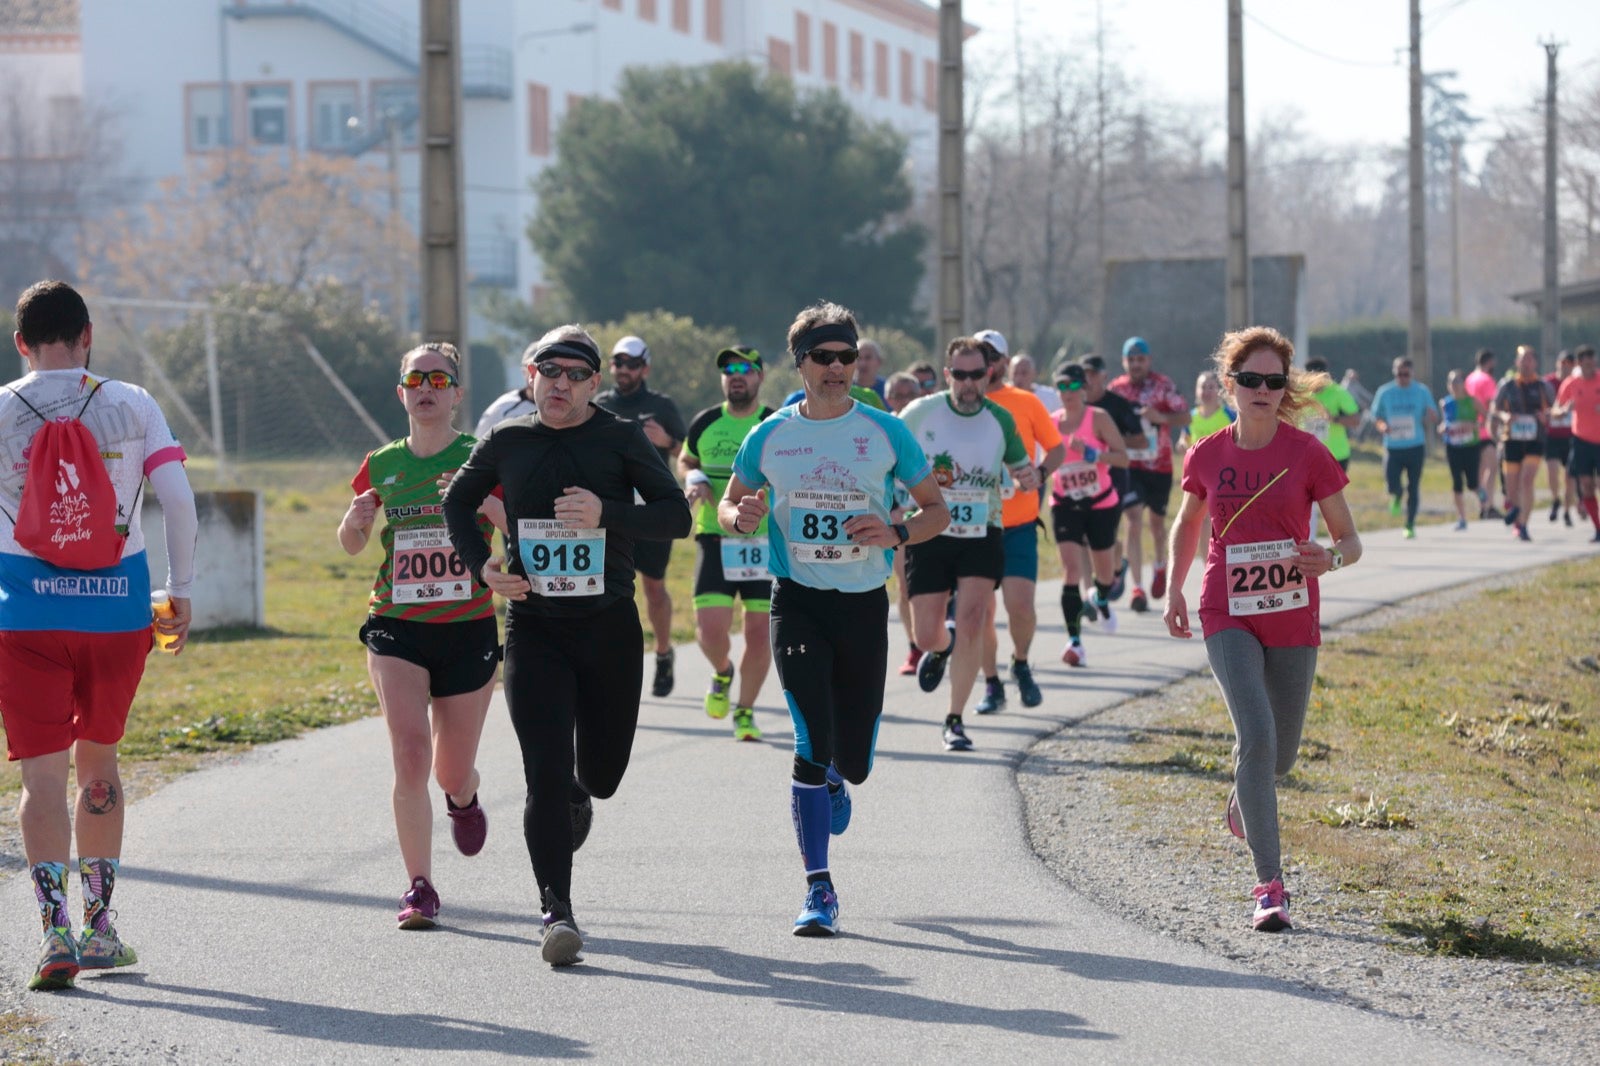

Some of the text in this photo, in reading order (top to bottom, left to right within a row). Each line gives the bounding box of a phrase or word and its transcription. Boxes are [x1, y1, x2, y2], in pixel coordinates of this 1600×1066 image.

[1061, 471, 1097, 490] 2150
[810, 492, 823, 500] GRAN
[824, 493, 842, 501] PREMIO
[51, 527, 92, 549] deportes
[420, 531, 439, 539] PREMIO
[545, 530, 578, 538] DIPUTACIÓN
[397, 551, 466, 580] 2006
[532, 544, 591, 572] 918
[1231, 564, 1303, 593] 2204
